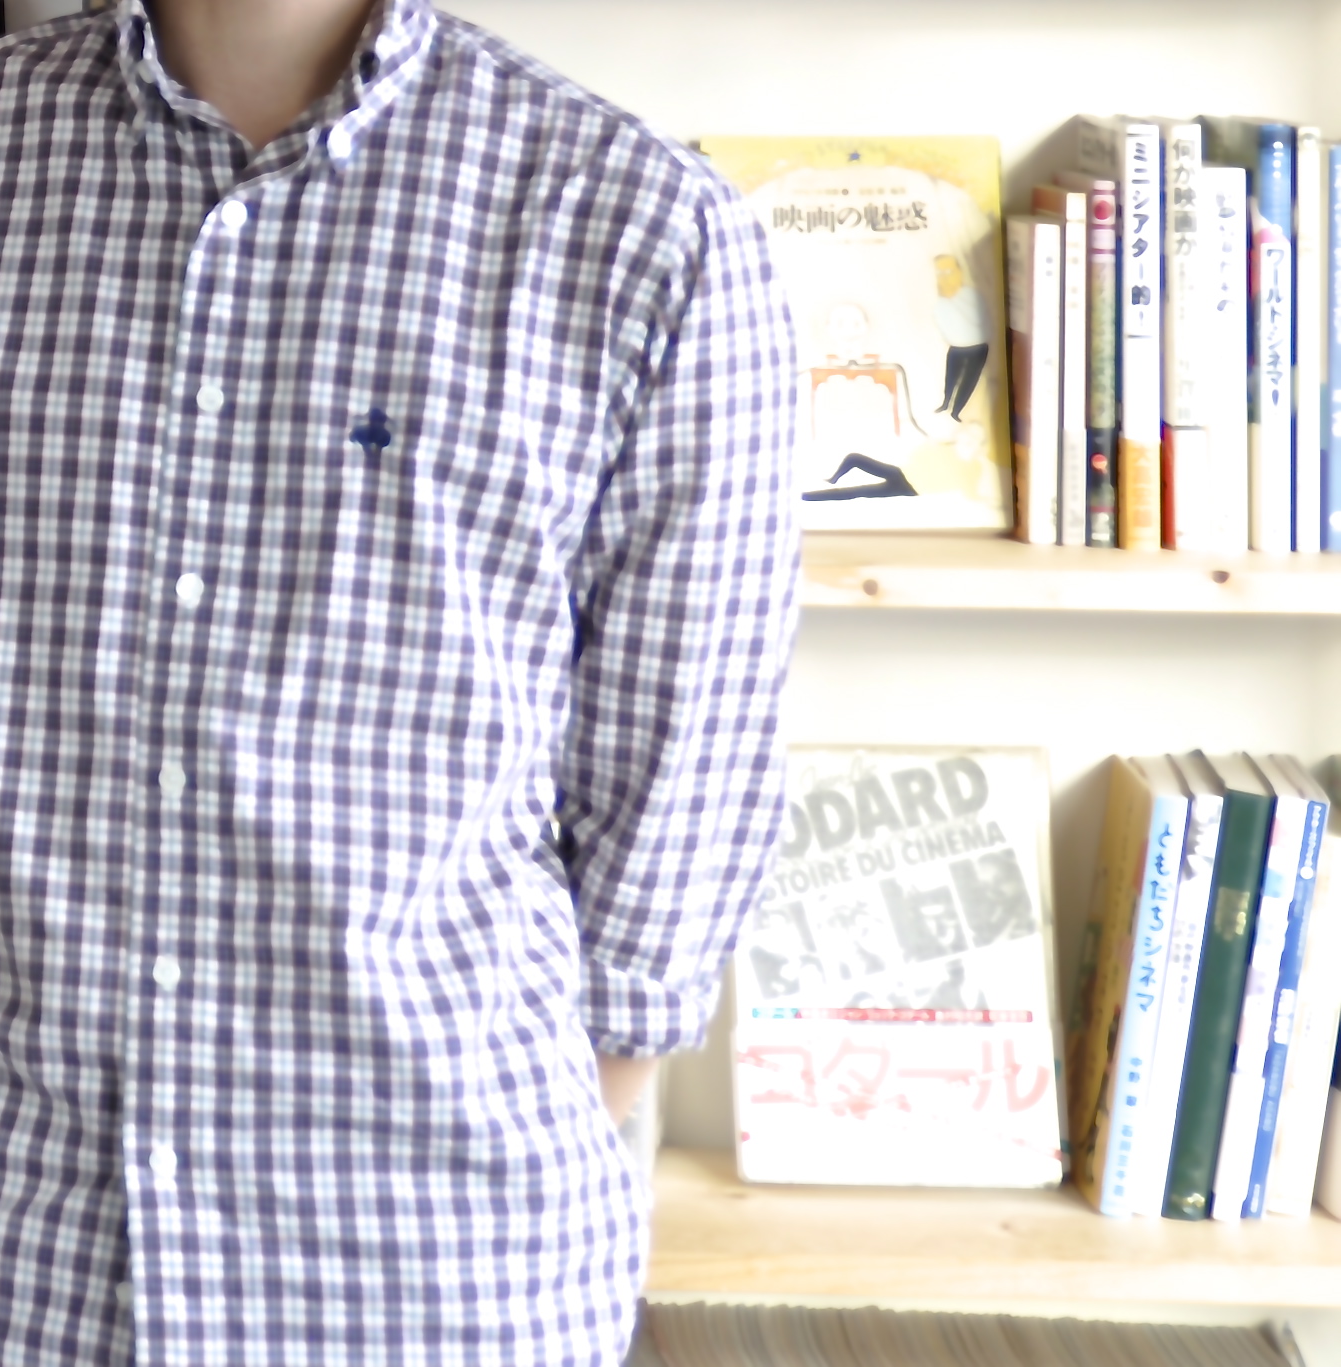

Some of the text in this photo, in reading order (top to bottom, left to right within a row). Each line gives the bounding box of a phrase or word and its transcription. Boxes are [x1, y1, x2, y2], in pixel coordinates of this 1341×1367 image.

[772, 201, 929, 234] 映画の魅惑
[858, 845, 897, 874] DU
[1134, 822, 1175, 1013] ともだちシネマ
